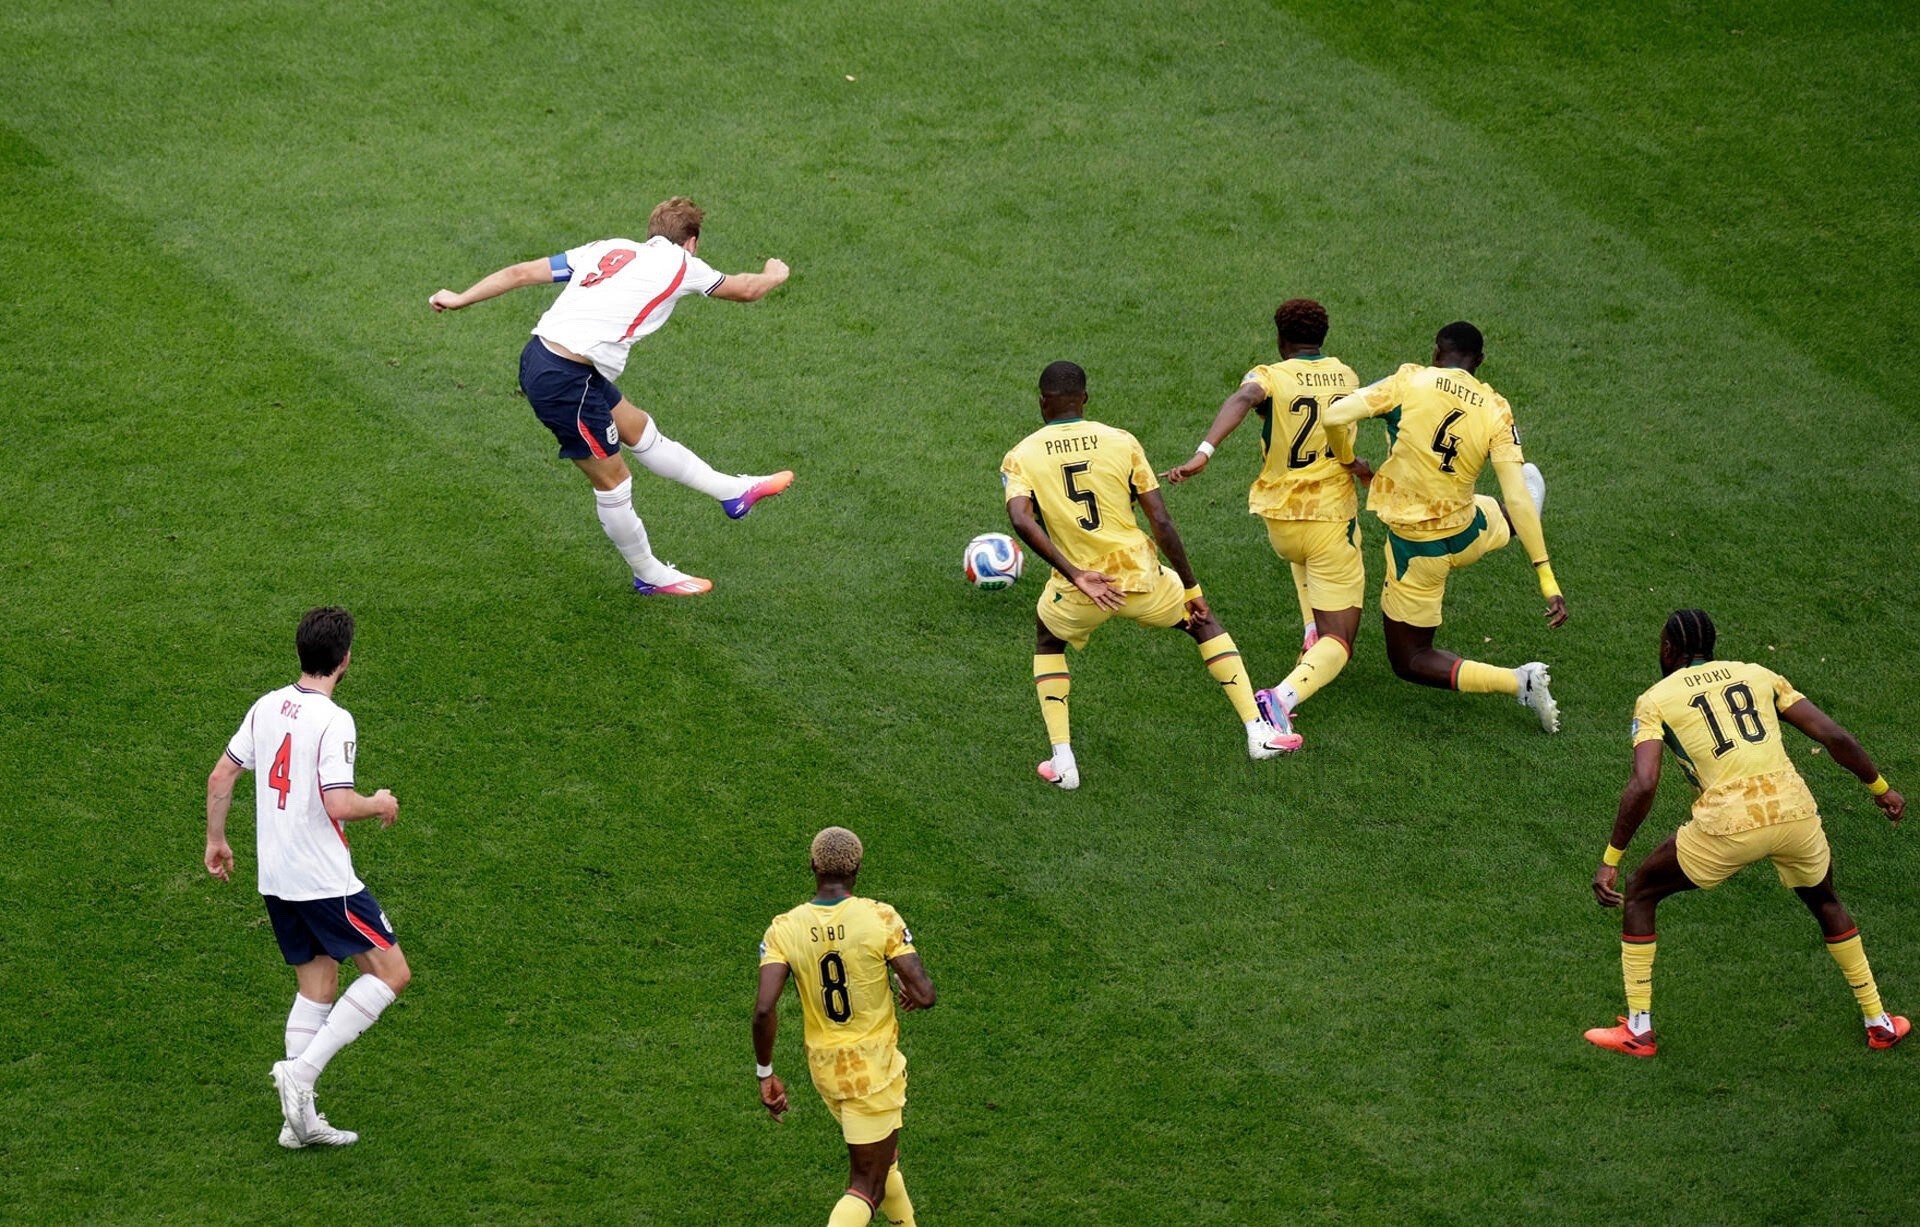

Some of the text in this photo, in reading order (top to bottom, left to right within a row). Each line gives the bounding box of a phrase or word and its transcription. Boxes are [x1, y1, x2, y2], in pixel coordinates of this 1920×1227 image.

[579, 248, 637, 289] 9
[1296, 372, 1346, 387] SENAYA
[1045, 434, 1099, 455] PARTEY
[1430, 407, 1468, 476] 4
[1060, 460, 1105, 533] 5
[1683, 667, 1732, 688] OPOKU
[1687, 679, 1771, 760] 18
[268, 732, 293, 811] 4
[818, 949, 854, 1026] 8
